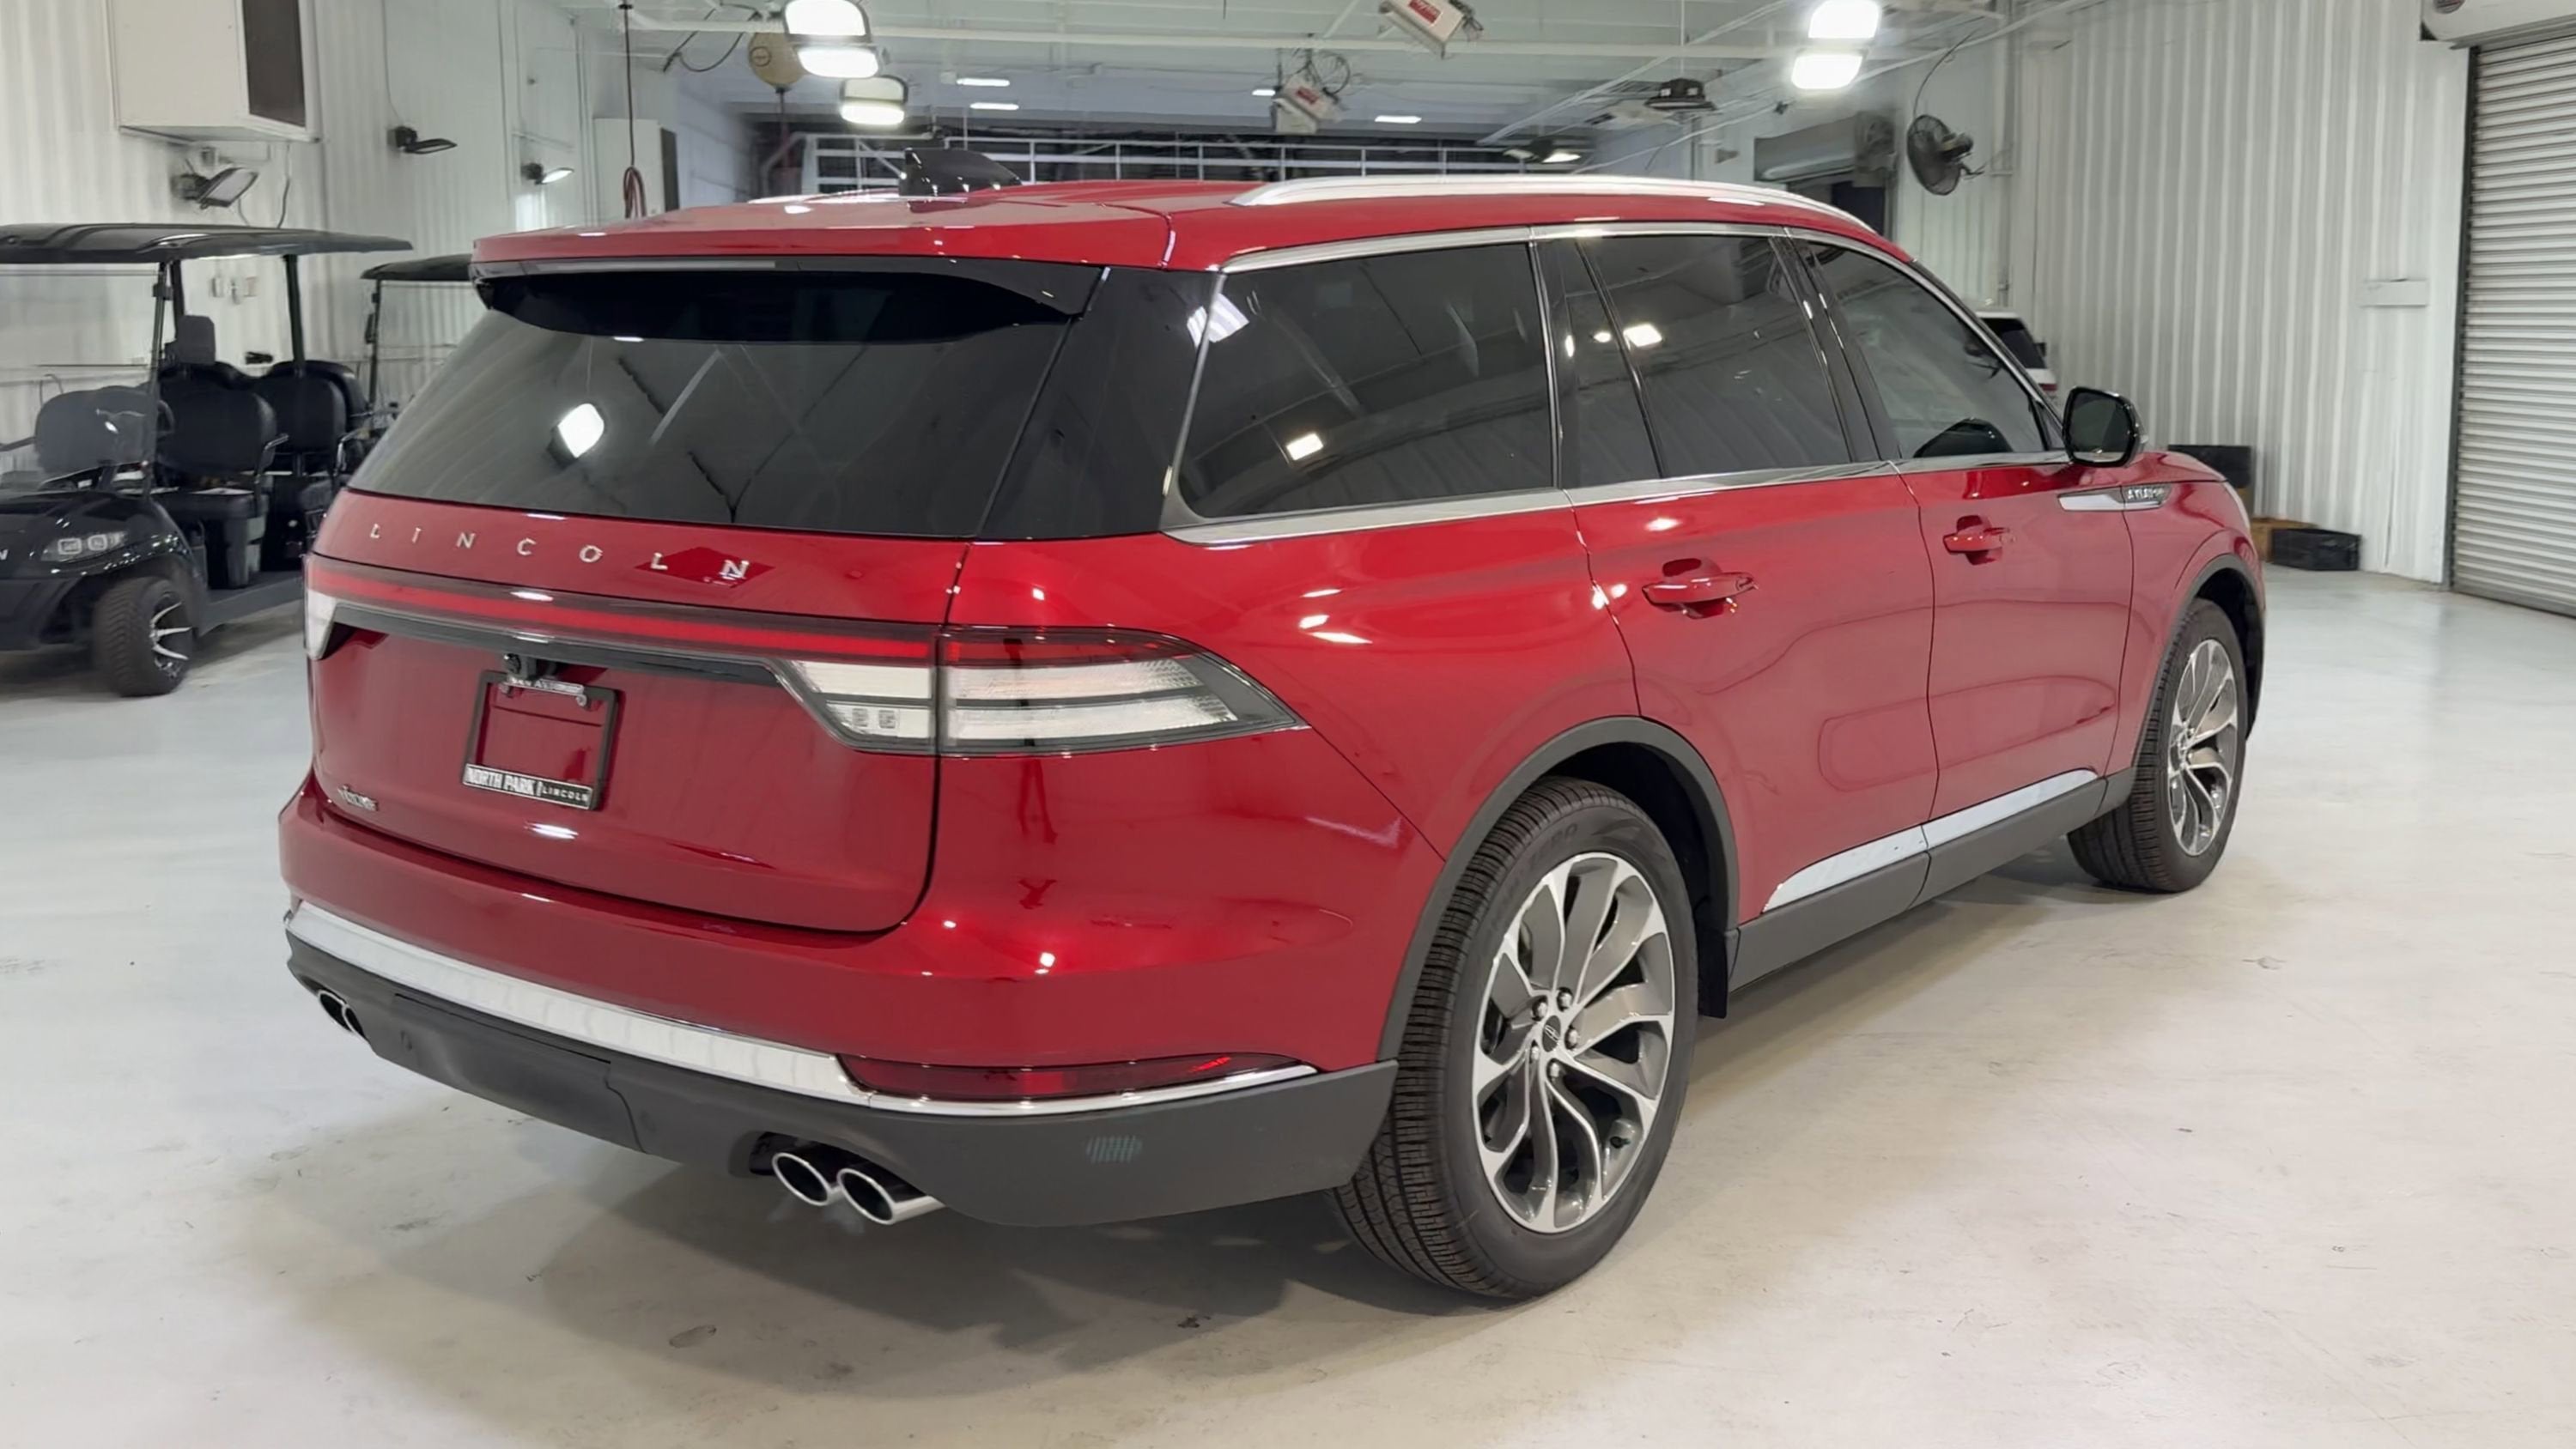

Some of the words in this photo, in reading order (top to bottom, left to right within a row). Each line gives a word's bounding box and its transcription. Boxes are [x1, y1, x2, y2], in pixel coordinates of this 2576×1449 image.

[369, 523, 750, 579] LINCOLN
[465, 767, 503, 789] NORTH
[503, 774, 536, 796] PARK
[542, 785, 589, 802] LINCOLN
